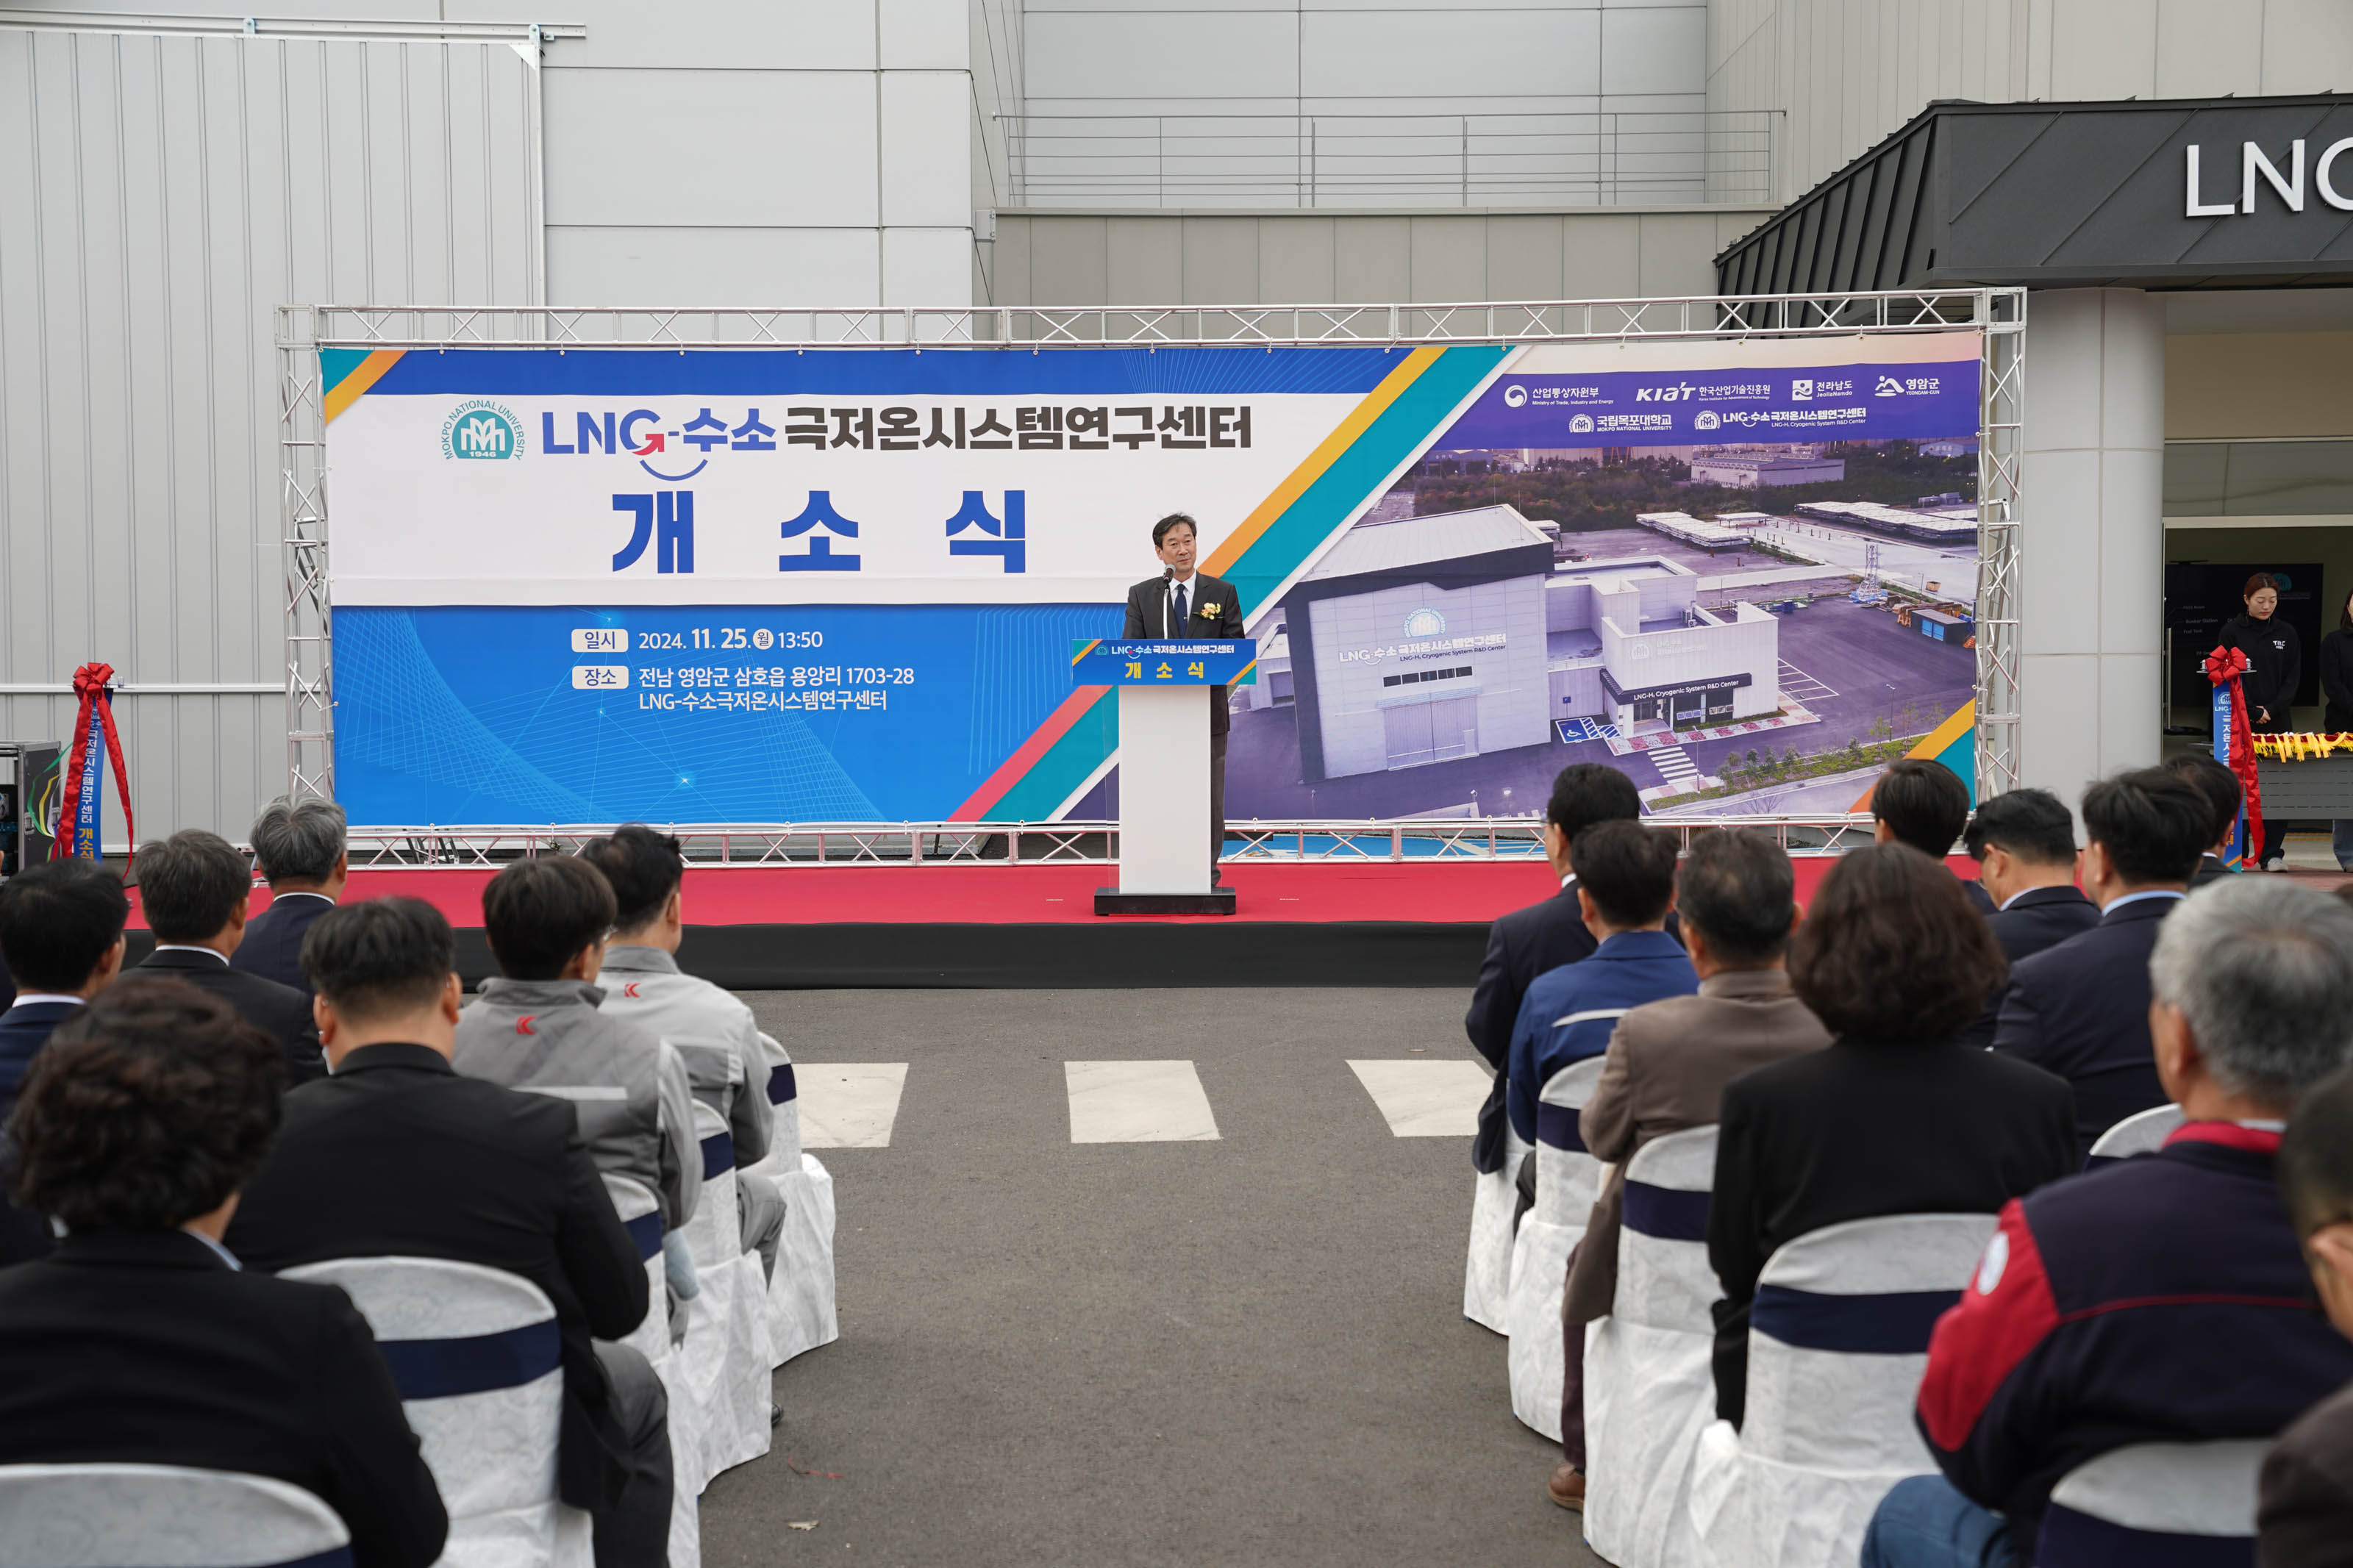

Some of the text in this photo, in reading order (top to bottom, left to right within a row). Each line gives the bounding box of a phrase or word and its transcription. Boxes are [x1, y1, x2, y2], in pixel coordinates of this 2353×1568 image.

[1532, 387, 1599, 398] 산업통상자원부
[1699, 384, 1771, 396] 한국산업기술진흥원
[1816, 380, 1852, 391] 전라남도
[1905, 378, 1940, 390] 영암군
[441, 399, 525, 460] MOKPO NATIONAL UNIVERSITY
[785, 406, 1252, 451] 극저온시스템연구센터
[1596, 415, 1672, 426] 국립목포대학교
[585, 631, 616, 650] 일시
[638, 633, 687, 649] 2024.
[691, 628, 715, 649] 11.
[721, 628, 751, 649] 25.
[778, 631, 824, 649] 13:50
[1421, 651, 1452, 659] Cryogenic
[585, 667, 617, 687] 장소
[639, 666, 915, 688] 전남 영암군 삼호읍 용앙리 1703-28
[1655, 687, 1685, 698] Cryogenic
[1685, 684, 1707, 693] System
[1720, 680, 1740, 689] Center
[639, 690, 887, 712] LNG-수소극저온시스템연구센터
